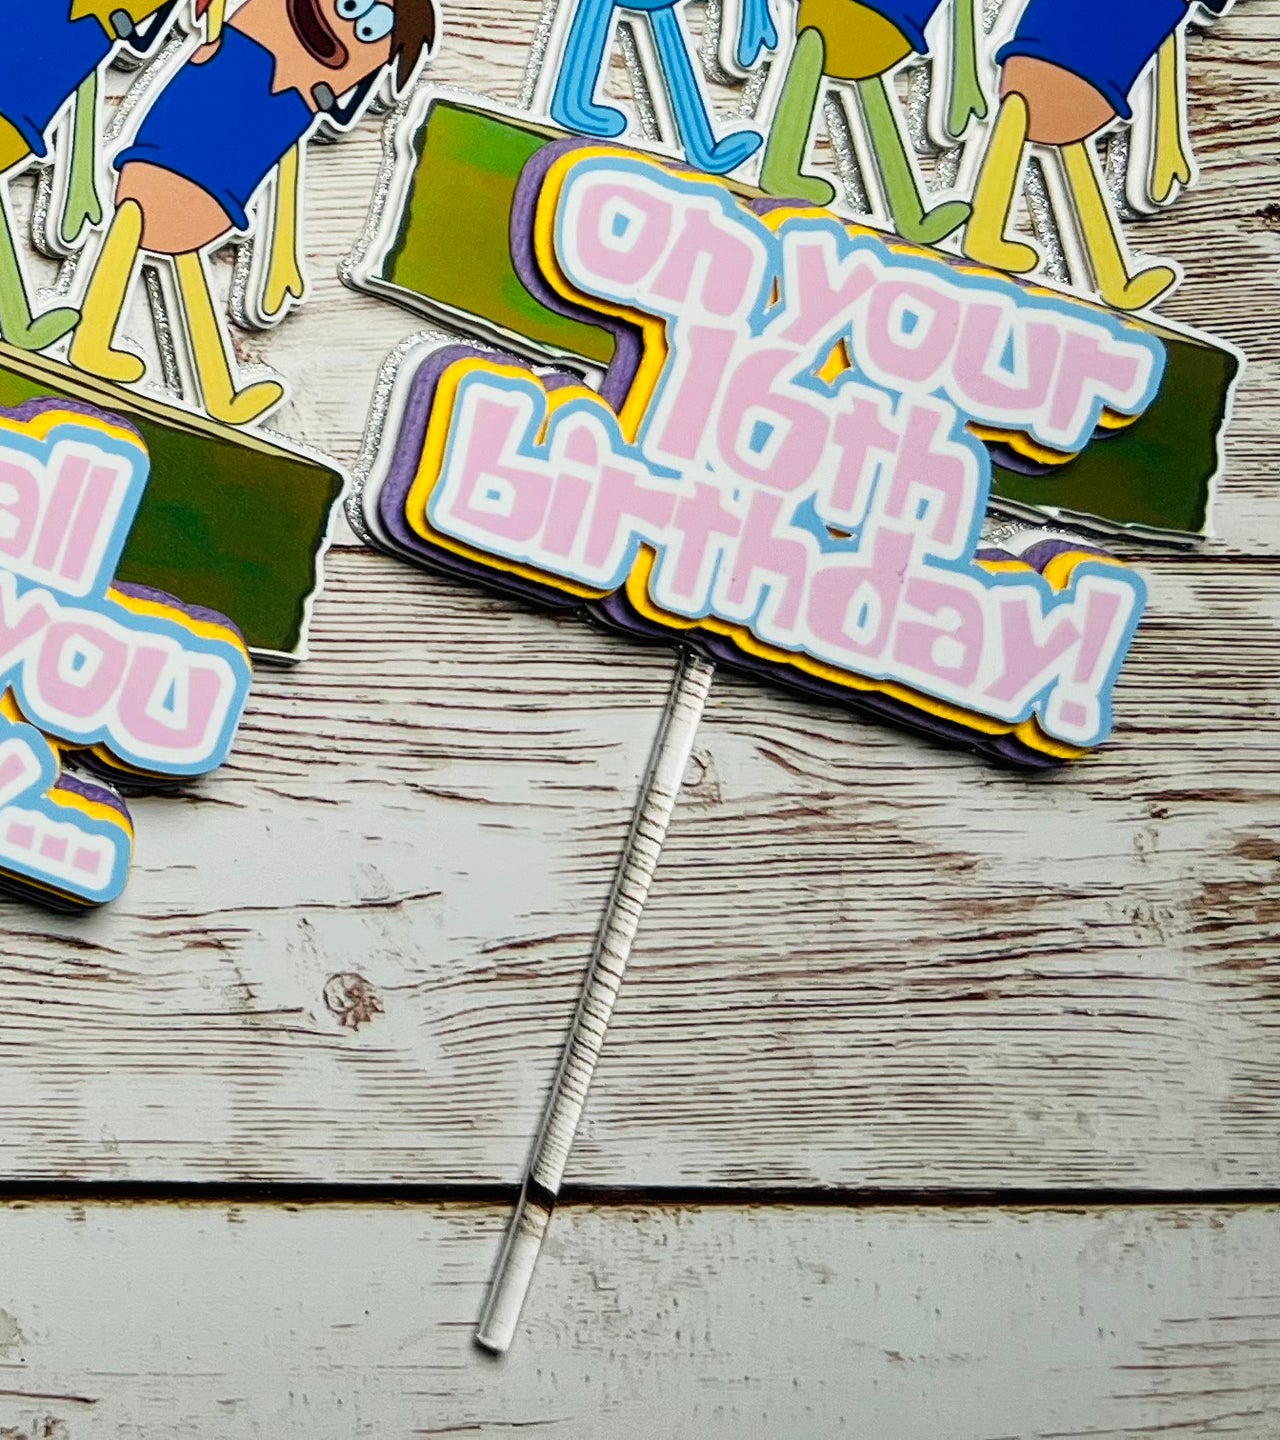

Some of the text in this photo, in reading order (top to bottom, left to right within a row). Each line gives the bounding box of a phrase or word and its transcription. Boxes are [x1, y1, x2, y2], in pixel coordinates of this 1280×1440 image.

[659, 326, 965, 545] 16th
[783, 243, 1146, 433] your
[452, 400, 1121, 726] birthday!
